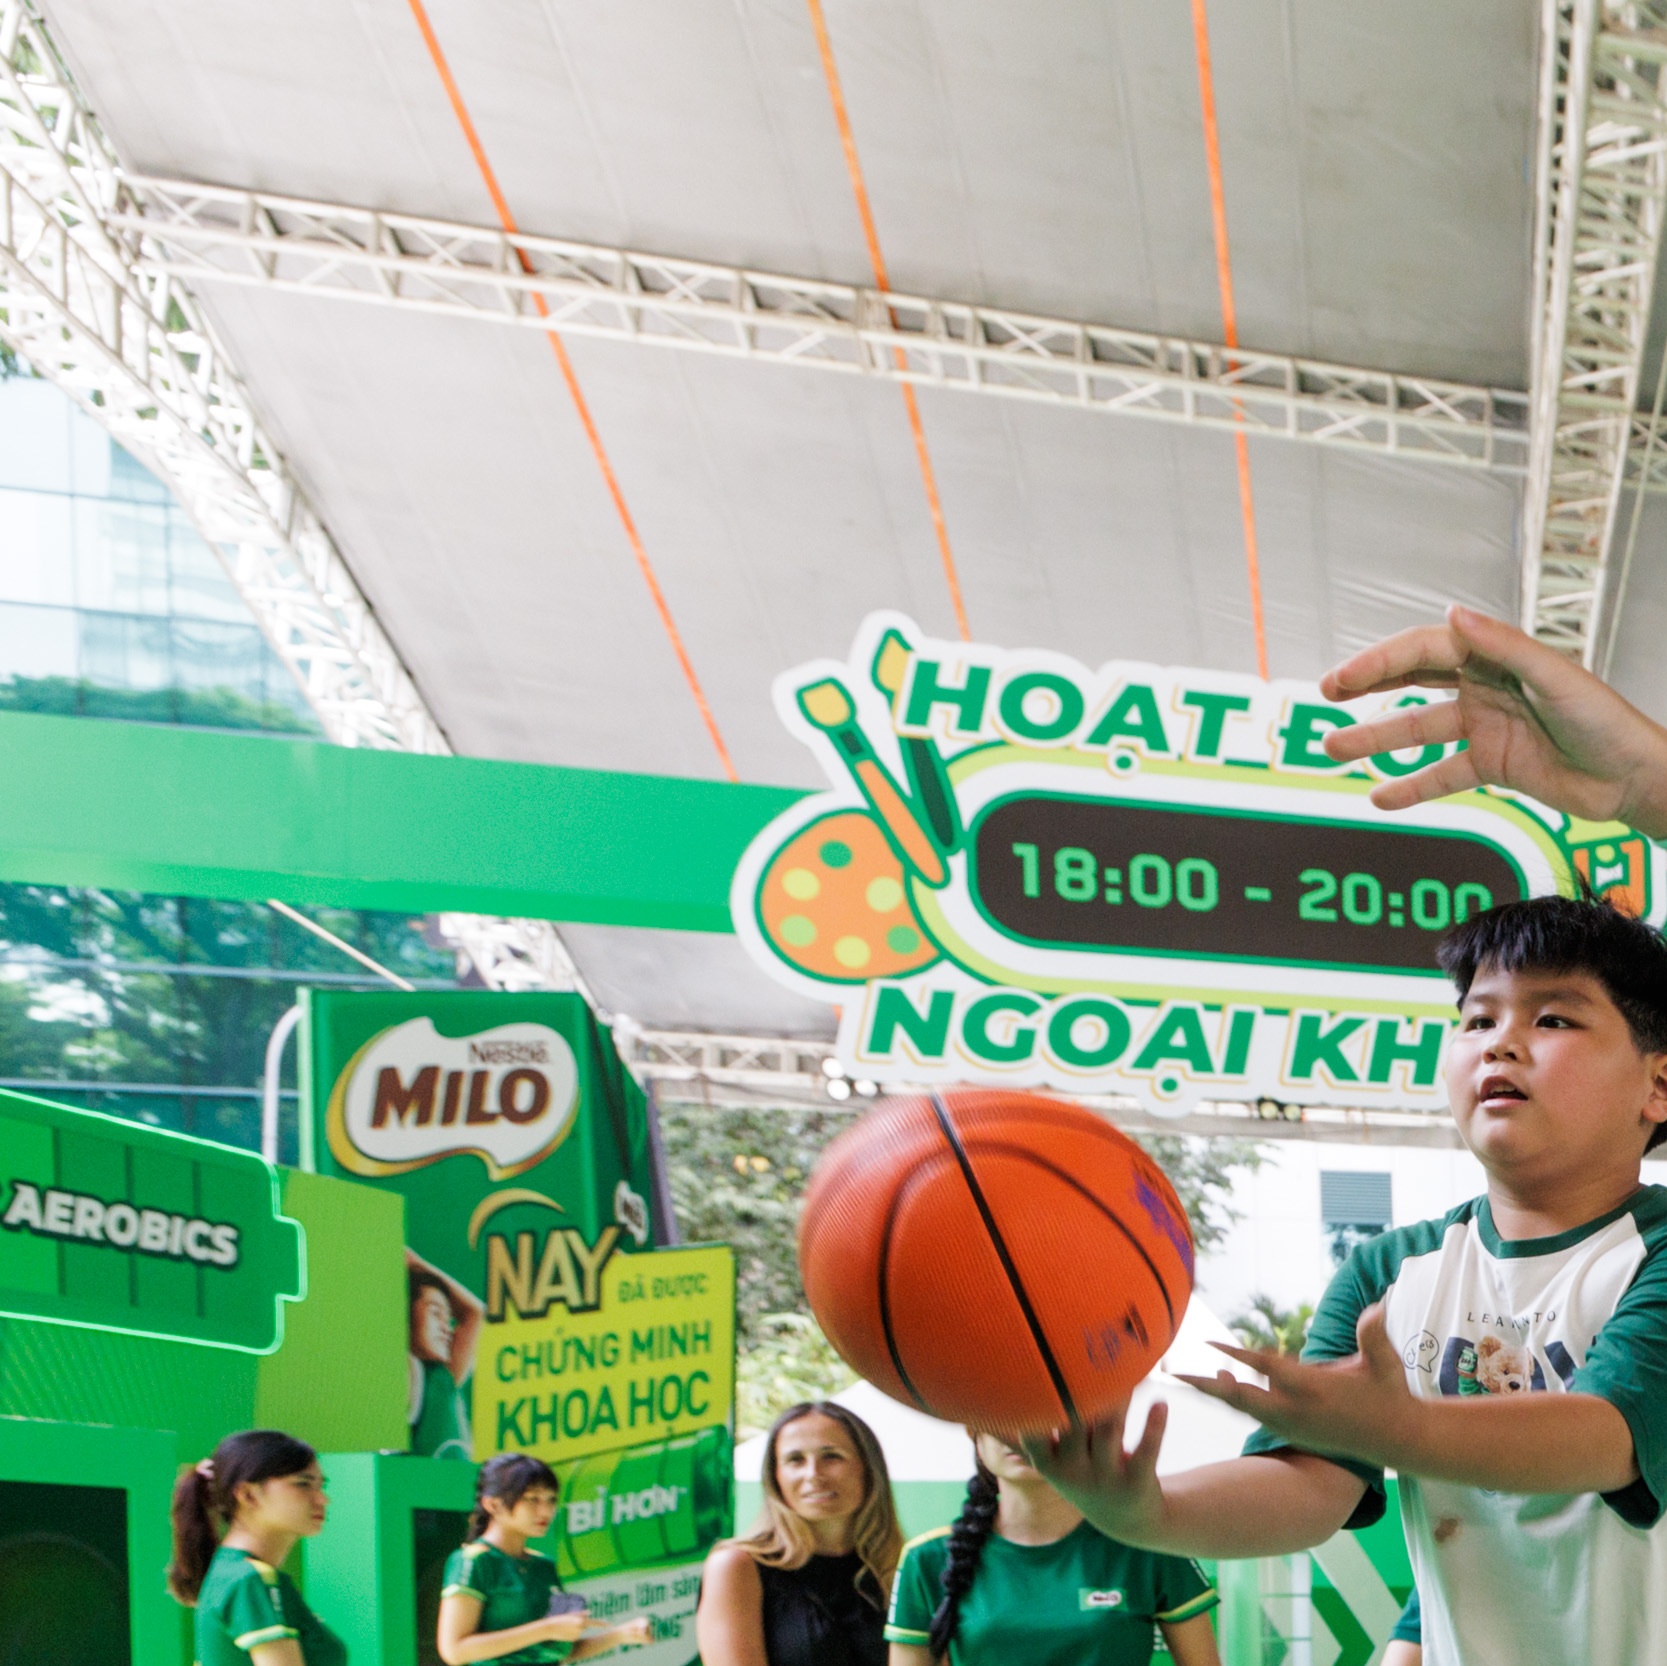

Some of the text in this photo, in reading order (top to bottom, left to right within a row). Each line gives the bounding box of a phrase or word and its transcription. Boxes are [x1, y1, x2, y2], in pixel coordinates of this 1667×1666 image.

[903, 658, 1250, 770] HOẠT
[1012, 840, 1220, 914] 18:00
[1297, 867, 1494, 931] 20:00
[867, 986, 1445, 1097] NGOẠI KH
[370, 1065, 551, 1130] MILO
[6, 1181, 240, 1267] AEROBICS
[486, 1225, 618, 1317] NAY
[496, 1320, 712, 1383] CHỨNG MINH
[495, 1370, 710, 1450] KHOA HỌC
